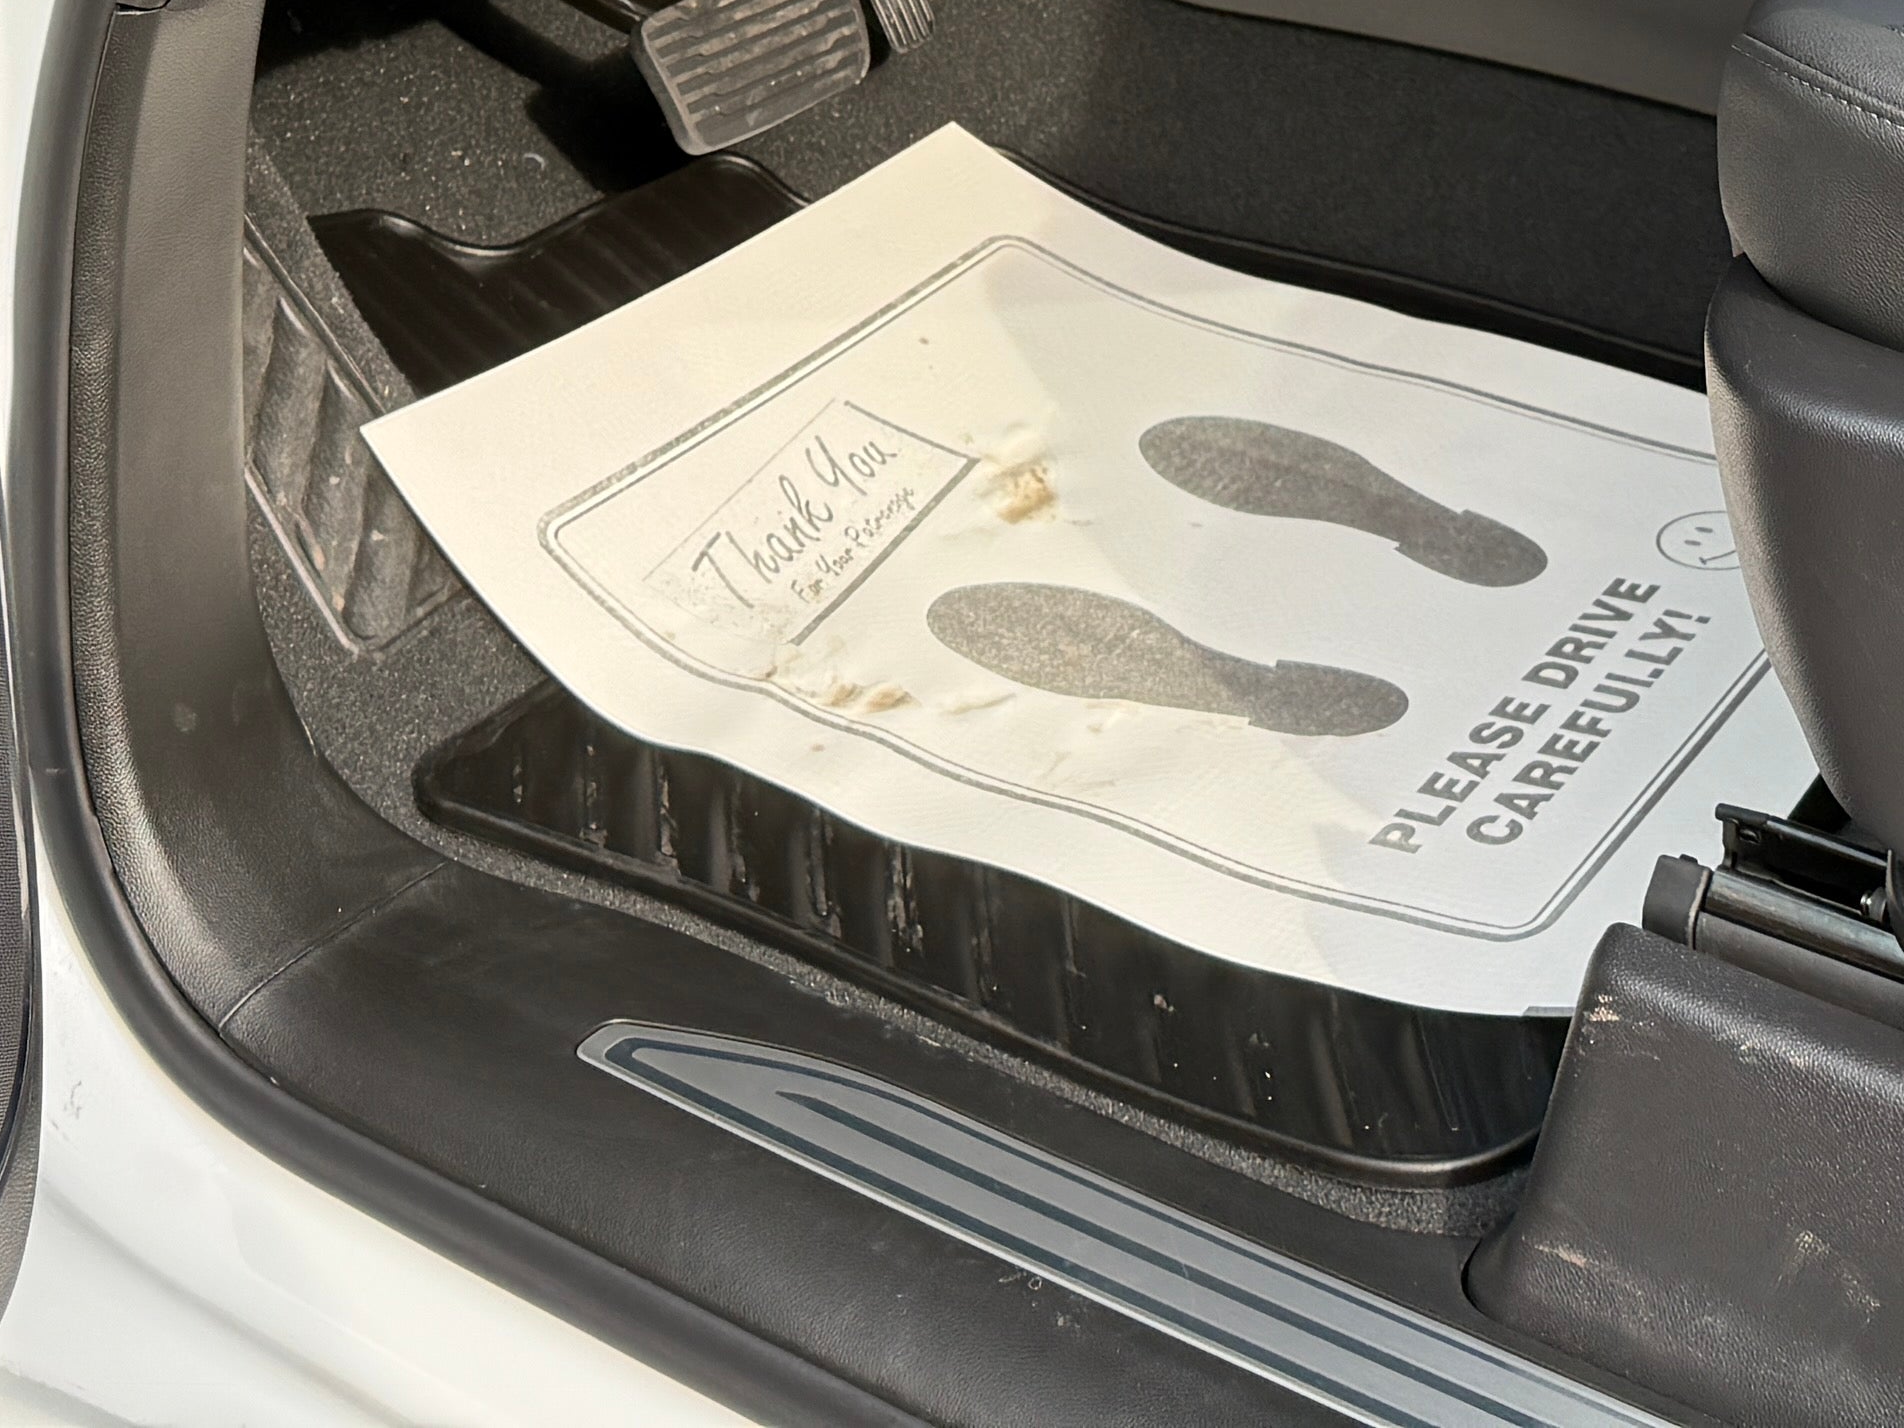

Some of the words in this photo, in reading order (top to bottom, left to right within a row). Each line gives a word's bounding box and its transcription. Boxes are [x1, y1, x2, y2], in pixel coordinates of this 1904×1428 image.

[691, 474, 834, 610] Thank
[805, 435, 898, 496] You
[790, 578, 825, 605] For
[815, 553, 855, 577] Your
[1368, 695, 1552, 854] PLEASE
[1521, 577, 1661, 690] DRIVE
[1465, 608, 1712, 847] CAREFULLY!
